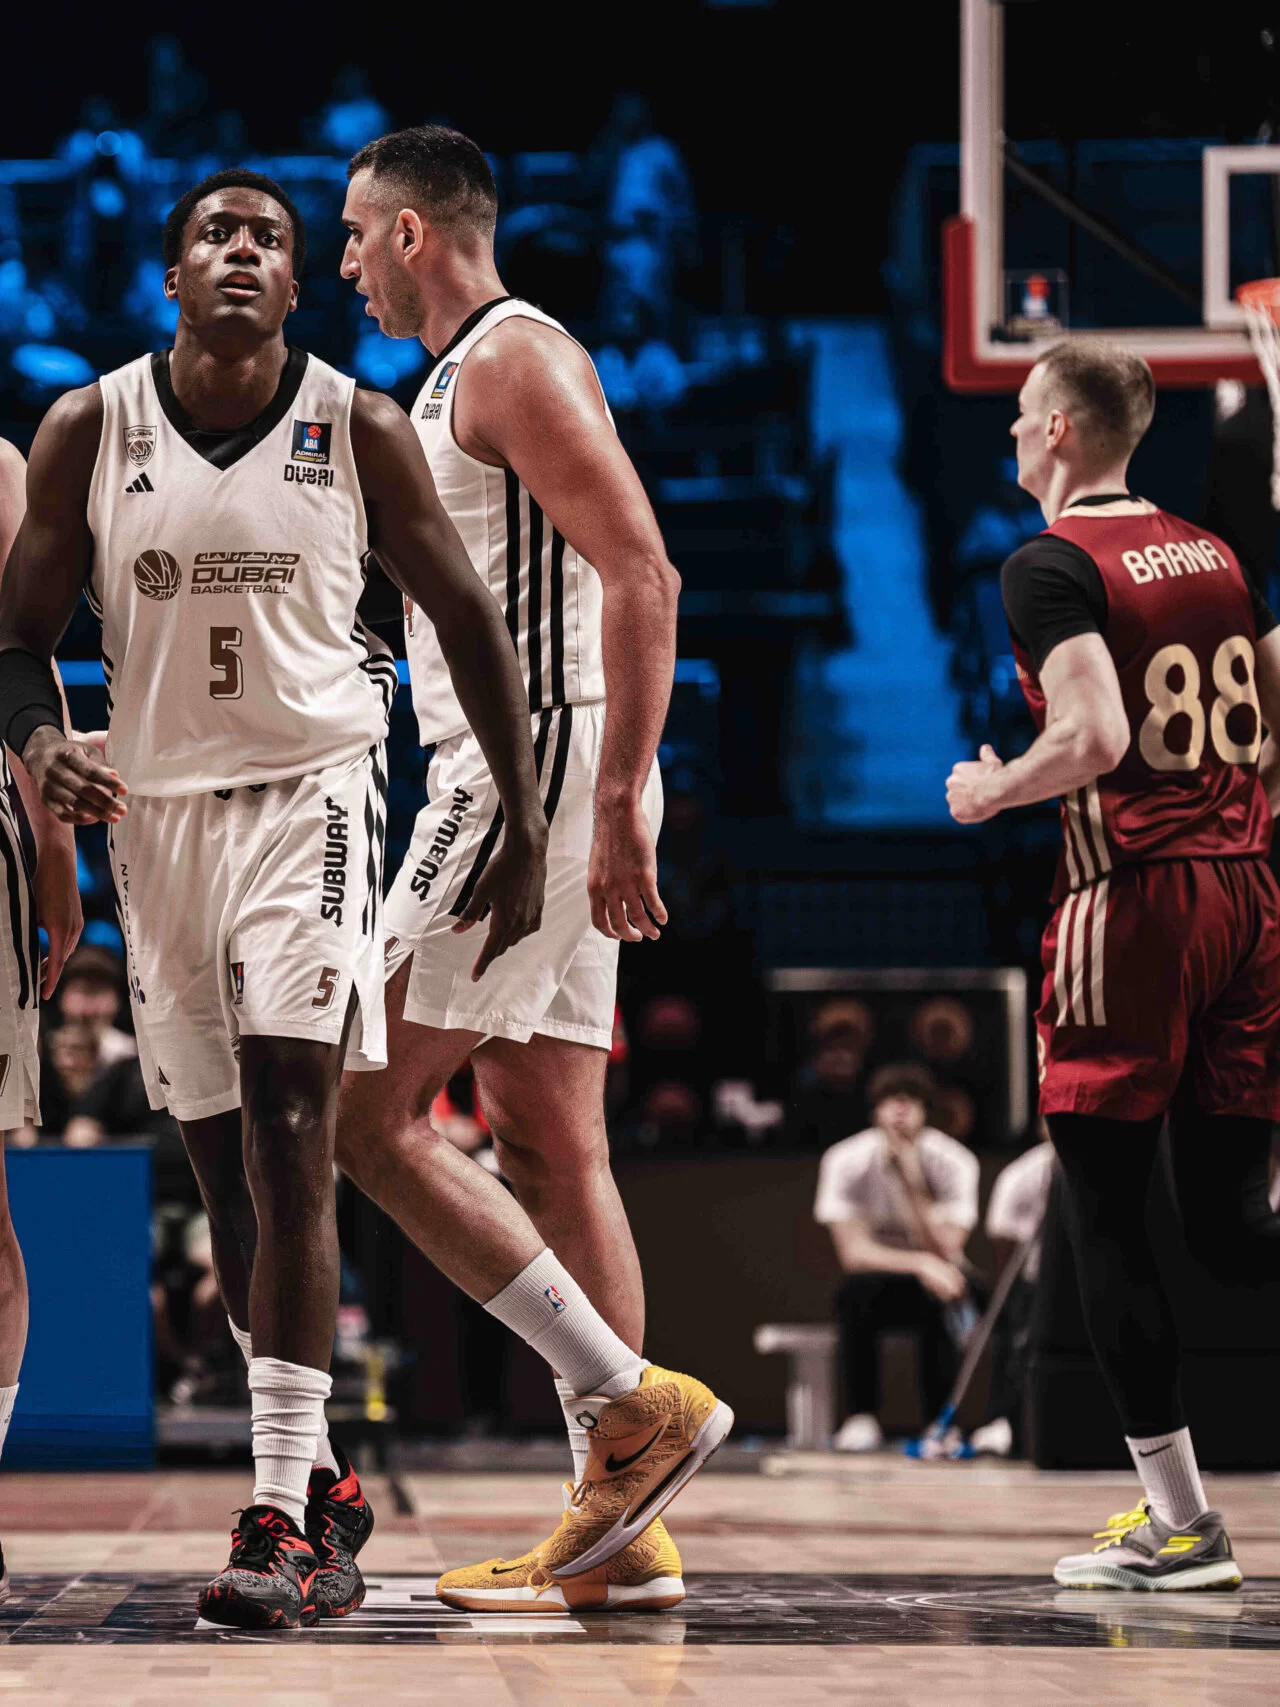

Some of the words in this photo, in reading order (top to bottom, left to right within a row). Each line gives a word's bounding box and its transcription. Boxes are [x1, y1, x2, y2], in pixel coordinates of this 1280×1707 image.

[304, 438, 318, 450] ABA
[284, 464, 334, 487] DUBAI
[192, 566, 295, 584] DUBAI
[1122, 539, 1228, 585] BARNA
[190, 584, 290, 595] BASKETBALL
[209, 626, 244, 700] 5
[1139, 635, 1262, 772] 88
[320, 796, 349, 928] SUBWAY
[411, 784, 474, 902] SUBWAY
[311, 966, 341, 1011] 5
